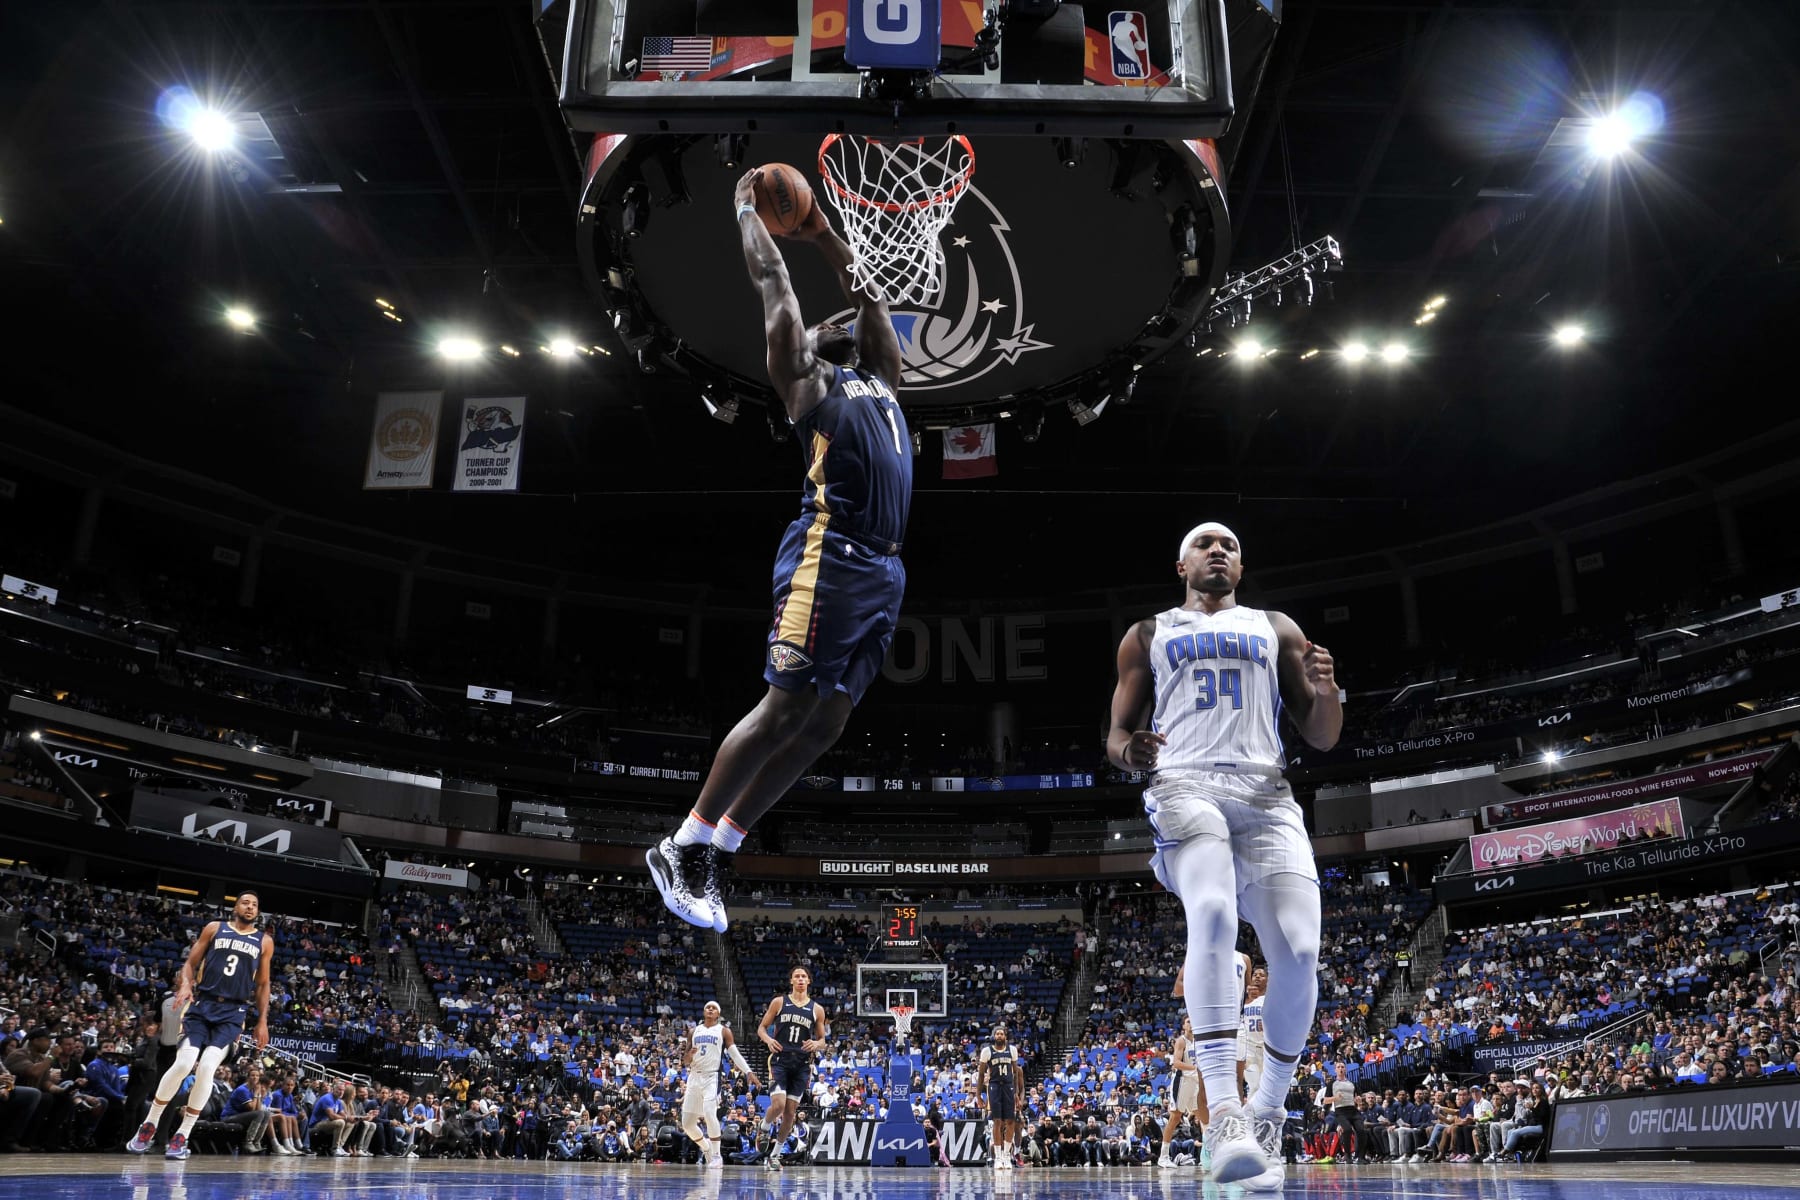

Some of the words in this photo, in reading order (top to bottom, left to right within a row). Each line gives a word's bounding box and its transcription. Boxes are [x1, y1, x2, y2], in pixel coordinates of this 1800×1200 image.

[1117, 63, 1136, 75] NBA
[841, 380, 873, 400] NEW
[886, 407, 902, 454] 1
[465, 458, 495, 467] TURNER
[496, 457, 511, 467] CUP
[376, 469, 402, 479] Amway
[465, 467, 508, 477] CHAMPIONS
[469, 478, 502, 487] 2000-2001
[880, 614, 1048, 684] ONE
[1165, 631, 1268, 673] MAGIC
[482, 689, 498, 700] 35
[1194, 668, 1243, 710] 34
[1627, 686, 1690, 709] Movement
[1538, 712, 1572, 727] KIA
[1354, 748, 1375, 758] The
[1378, 744, 1394, 755] Kia
[1397, 735, 1441, 752] Telluride
[1444, 731, 1475, 744] X-Pro
[54, 752, 98, 768] KIA
[630, 766, 660, 778] CURRENT
[856, 779, 861, 789] 9
[884, 779, 903, 790] 7:56
[912, 781, 920, 791] 1st
[945, 779, 953, 789] 11
[1055, 776, 1060, 788] 1
[1086, 775, 1092, 786] 6
[1524, 804, 1549, 813] EPCOT
[1552, 792, 1610, 808] INTERNATIONAL
[1611, 788, 1634, 797] FOOD
[1641, 782, 1660, 793] WINE
[1661, 775, 1696, 789] FESTIVAL
[1583, 861, 1610, 877] The
[1613, 855, 1636, 871] Kia
[1639, 842, 1700, 867] Telluride
[1703, 834, 1746, 856] X-Pro
[401, 865, 430, 880] Bally
[430, 872, 452, 880] SPORTS
[822, 862, 850, 873] BUD
[852, 863, 891, 873] LIGHT
[895, 863, 949, 873] BASELINE
[961, 863, 989, 873] BAR
[1474, 876, 1515, 892] KIA
[892, 907, 917, 919] 7:55
[889, 918, 915, 938] 21
[214, 938, 232, 949] NEW
[231, 939, 260, 959] ORLEANS
[223, 954, 239, 977] 3
[789, 1025, 801, 1043] 11
[270, 1036, 301, 1049] UXURY
[302, 1040, 337, 1053] VEHICLE
[700, 1044, 707, 1056] 5
[1474, 1047, 1513, 1060] OFFICIAL
[1513, 1044, 1549, 1057] LUXURY
[998, 1064, 1008, 1076] 14
[1628, 1107, 1697, 1135] OFFICIAL
[1701, 1101, 1779, 1131] LUXURY
[877, 1138, 924, 1150] KIA
